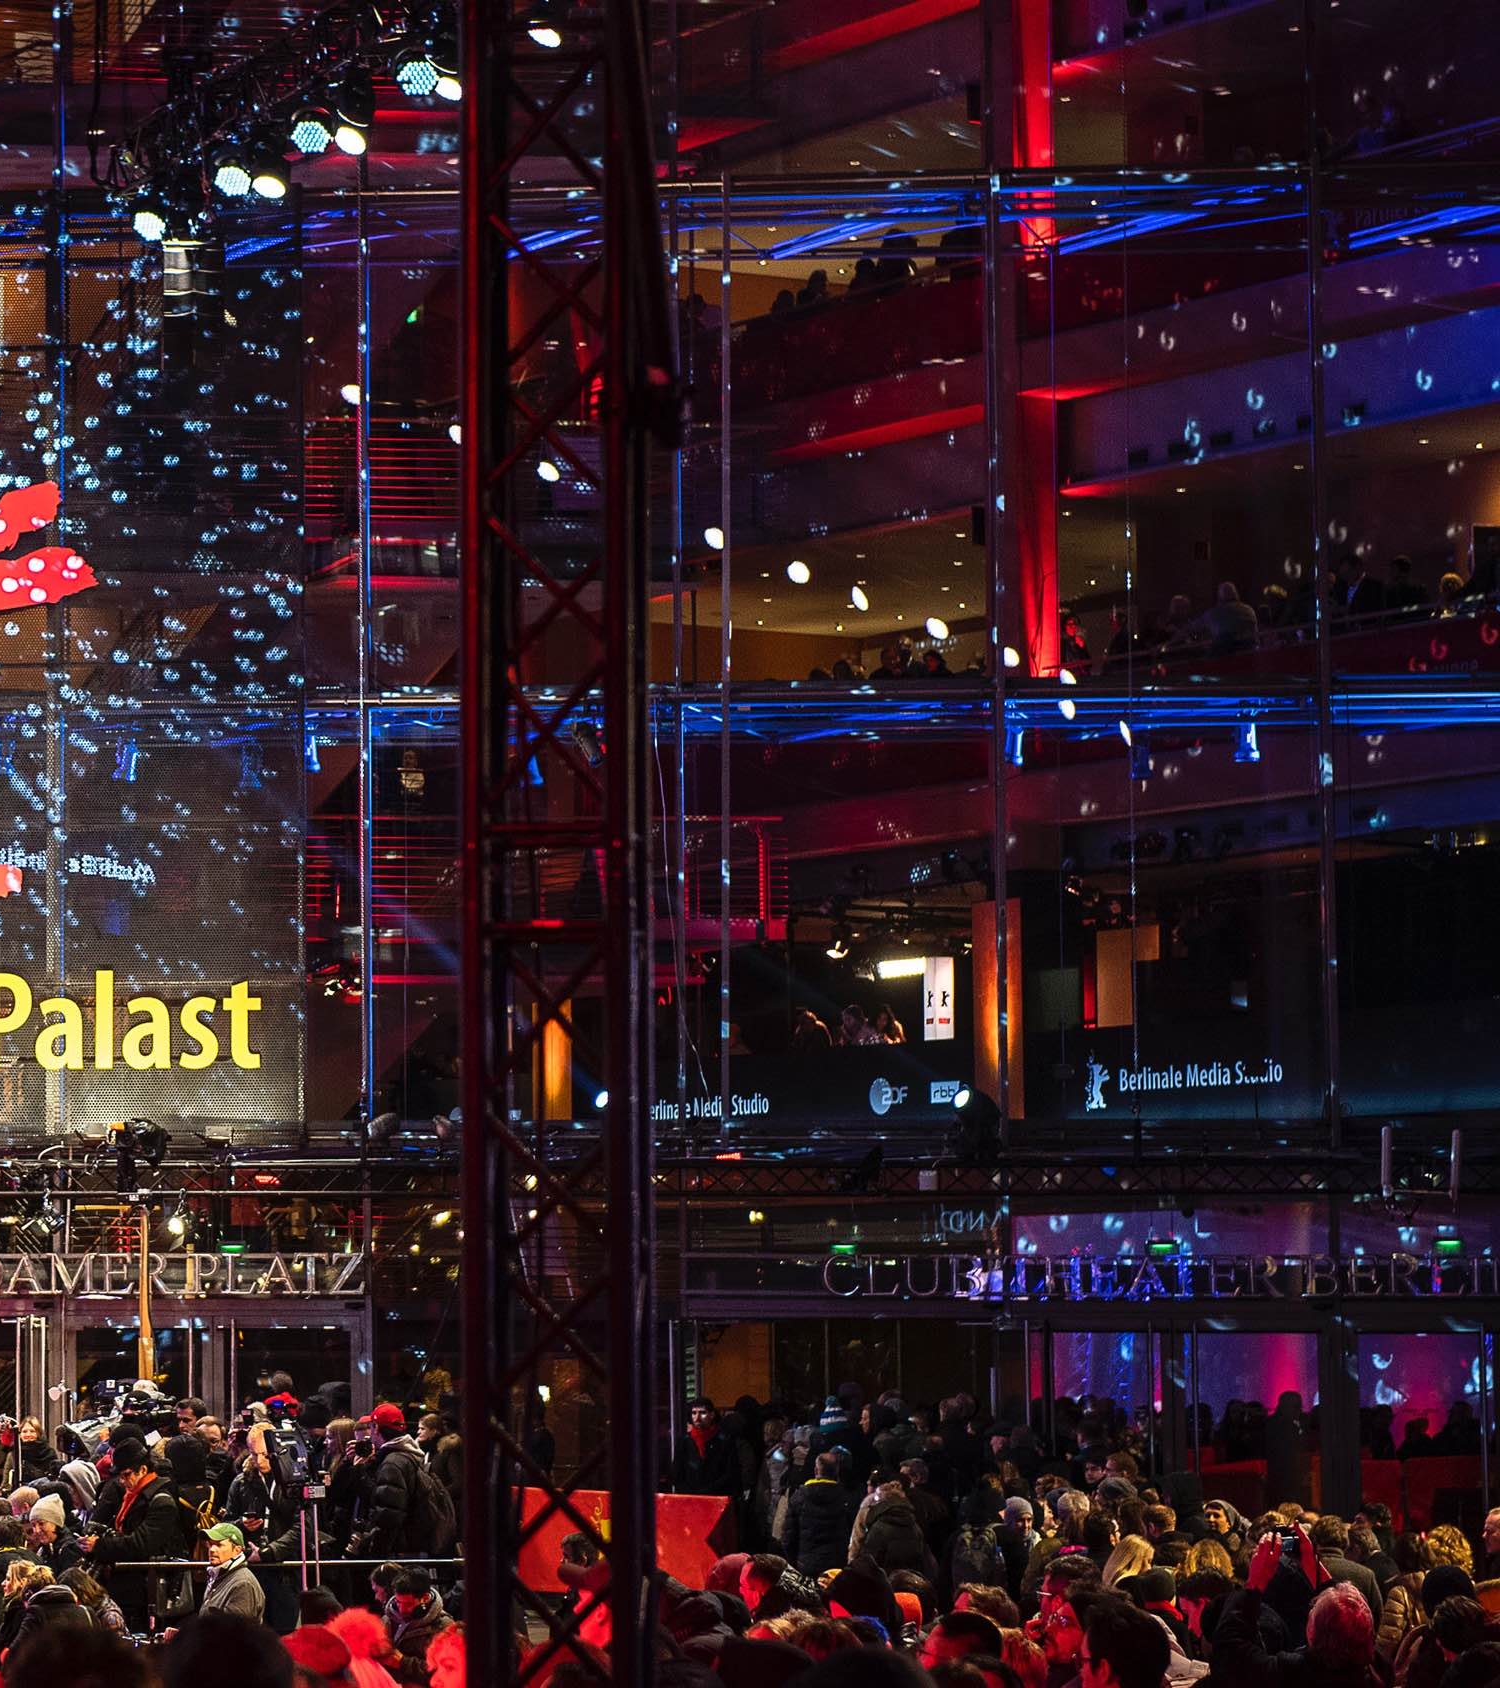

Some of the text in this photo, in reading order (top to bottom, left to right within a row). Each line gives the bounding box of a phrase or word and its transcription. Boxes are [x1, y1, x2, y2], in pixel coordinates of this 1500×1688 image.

[1118, 1063, 1183, 1092] Berlinale
[1186, 1061, 1231, 1088] Media
[650, 1092, 770, 1121] erlinae Medi Studio
[881, 1085, 909, 1105] ZDF
[932, 1085, 957, 1099] rbb
[190, 1252, 366, 1296] PLATZ
[823, 1252, 1500, 1299] CLUB THEATER BERLI
